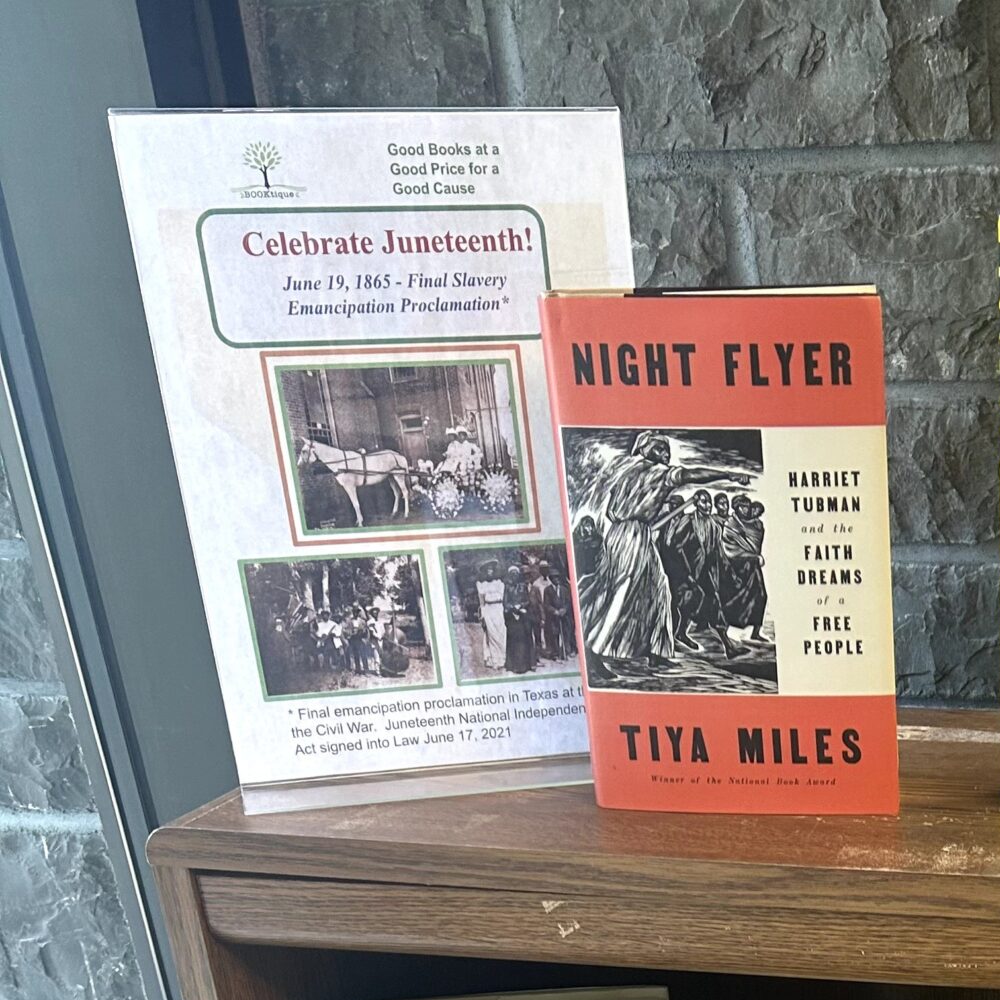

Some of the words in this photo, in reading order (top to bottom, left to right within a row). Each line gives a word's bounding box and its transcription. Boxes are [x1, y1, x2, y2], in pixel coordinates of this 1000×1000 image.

[388, 143, 424, 156] Good
[430, 143, 471, 155] Books
[476, 144, 487, 155] at
[492, 146, 499, 155] a
[393, 183, 428, 194] Good
[434, 182, 475, 194] Cause
[242, 230, 373, 257] Celebrate
[382, 227, 533, 254] Juneteenth!
[283, 274, 322, 292] June
[328, 274, 349, 292] 19,
[356, 273, 391, 290] 1865
[407, 273, 448, 288] Final
[452, 272, 507, 290] Slavery
[287, 300, 395, 318] Emancipation
[572, 343, 696, 386] NIGHT
[723, 343, 852, 386] FLYER
[789, 471, 860, 488] HARRIET
[792, 496, 861, 512] TUBMAN
[804, 545, 853, 560] FAITH
[798, 570, 862, 585] DREAMS
[813, 616, 851, 631] FREE
[803, 640, 863, 655] PEOPLE
[299, 706, 330, 720] Final
[334, 699, 420, 719] emancipation
[424, 693, 505, 712] proclamation
[509, 693, 519, 703] in
[523, 688, 559, 701] Texas
[562, 688, 574, 699] at
[620, 725, 709, 762] TIYA
[737, 727, 862, 764] MILES
